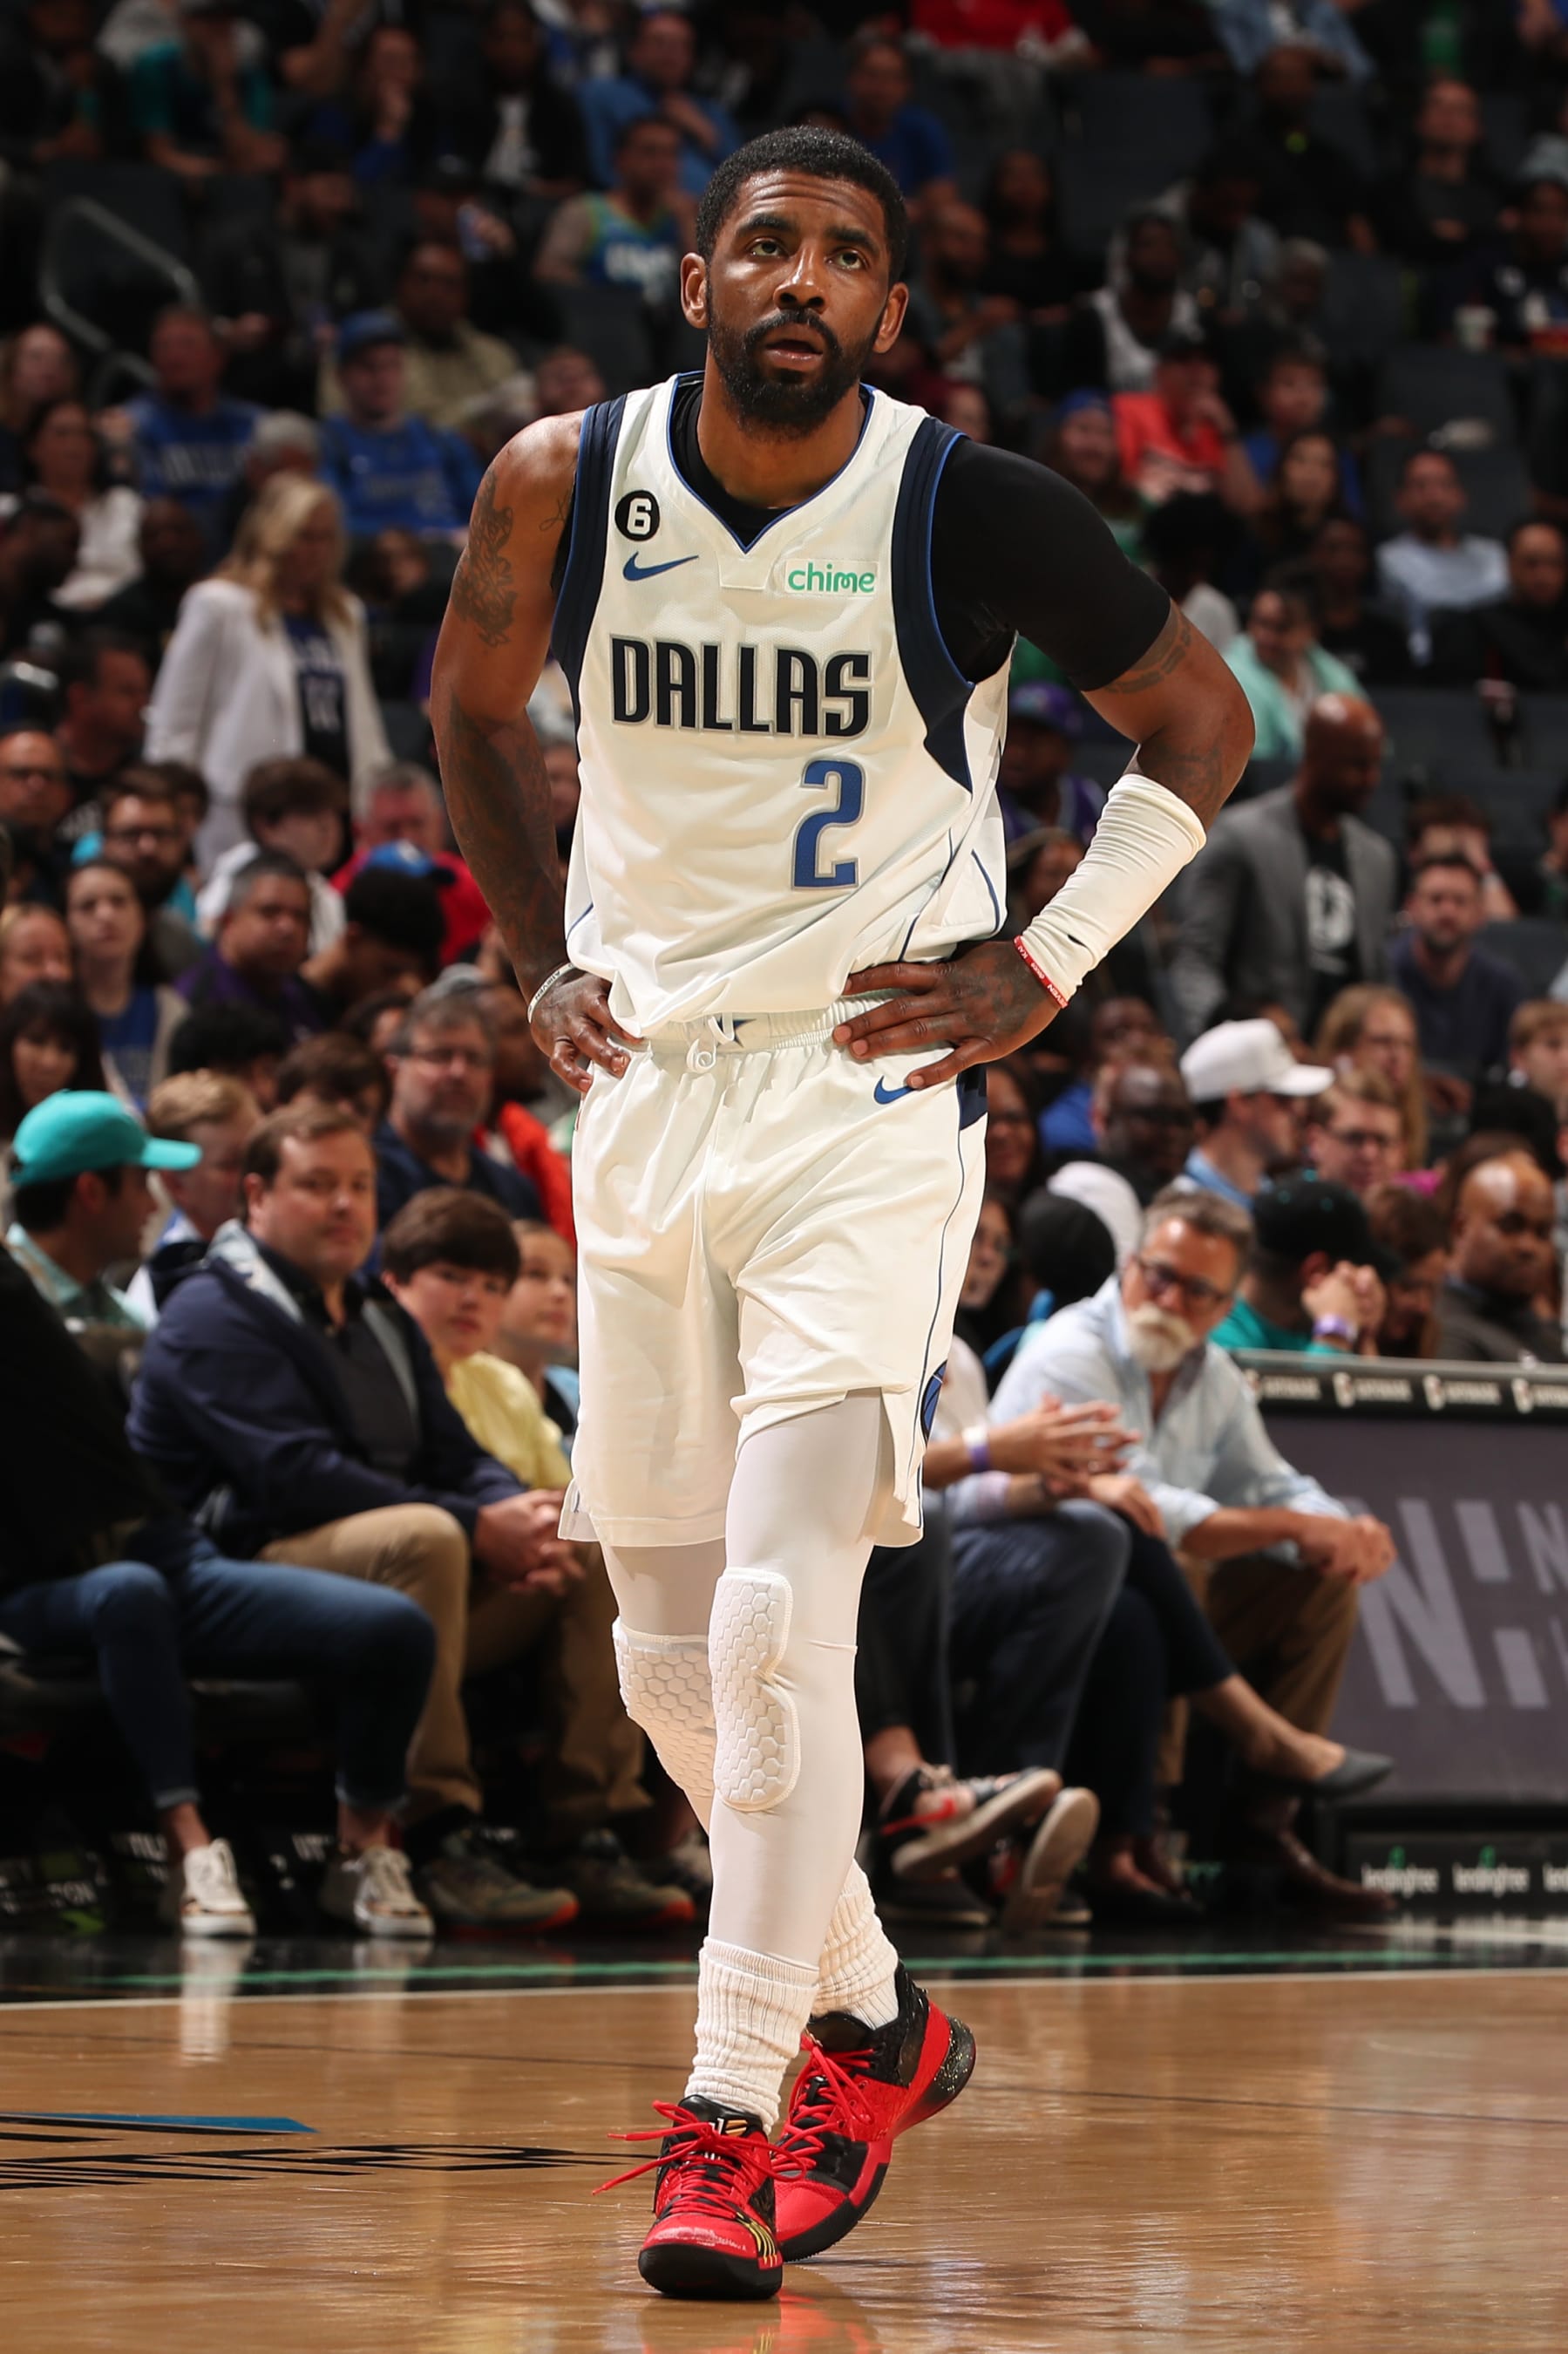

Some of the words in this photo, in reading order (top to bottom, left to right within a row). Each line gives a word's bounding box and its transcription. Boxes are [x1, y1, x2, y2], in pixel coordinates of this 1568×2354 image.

[627, 497, 652, 535] 6
[787, 561, 875, 594] chime
[610, 634, 872, 738] DALLAS
[791, 757, 866, 890] 2
